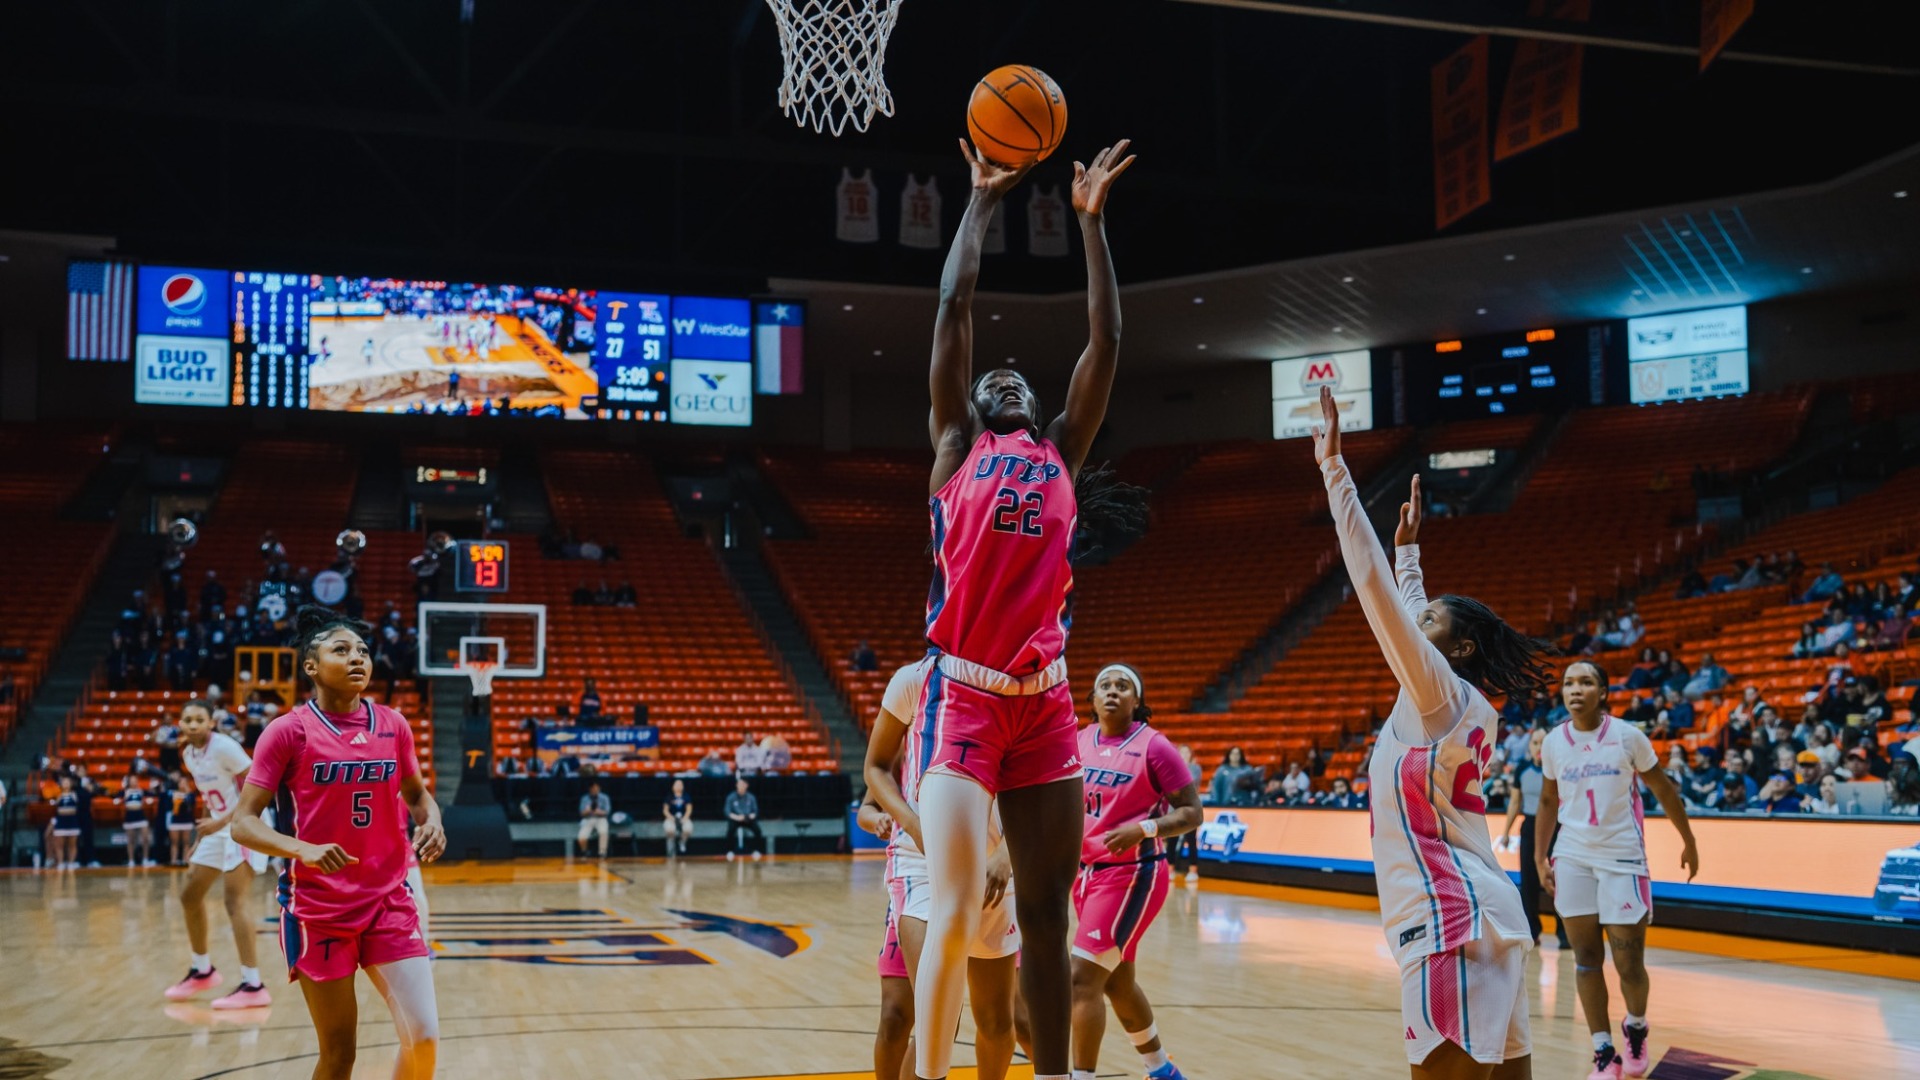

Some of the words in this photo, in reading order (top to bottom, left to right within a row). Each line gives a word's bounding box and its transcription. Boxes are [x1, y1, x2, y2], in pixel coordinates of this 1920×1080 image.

[847, 196, 869, 216] 10
[910, 202, 933, 224] 12
[698, 321, 751, 338] WestStar
[157, 348, 208, 366] BUD
[605, 337, 625, 358] 27
[643, 339, 661, 360] 51
[147, 365, 216, 382] LIGHT
[616, 365, 649, 386] 5:09
[1307, 361, 1335, 381] M
[673, 392, 747, 414] GECU
[973, 453, 1061, 484] UTEP
[991, 486, 1044, 538] 22
[475, 561, 499, 587] 13
[580, 731, 612, 742] CHEVY
[614, 730, 652, 741] REV-UP
[312, 759, 398, 785] UTEP
[1083, 765, 1136, 788] TEP
[351, 790, 373, 828] 5
[1085, 790, 1103, 820] 11
[1585, 788, 1600, 827] 1
